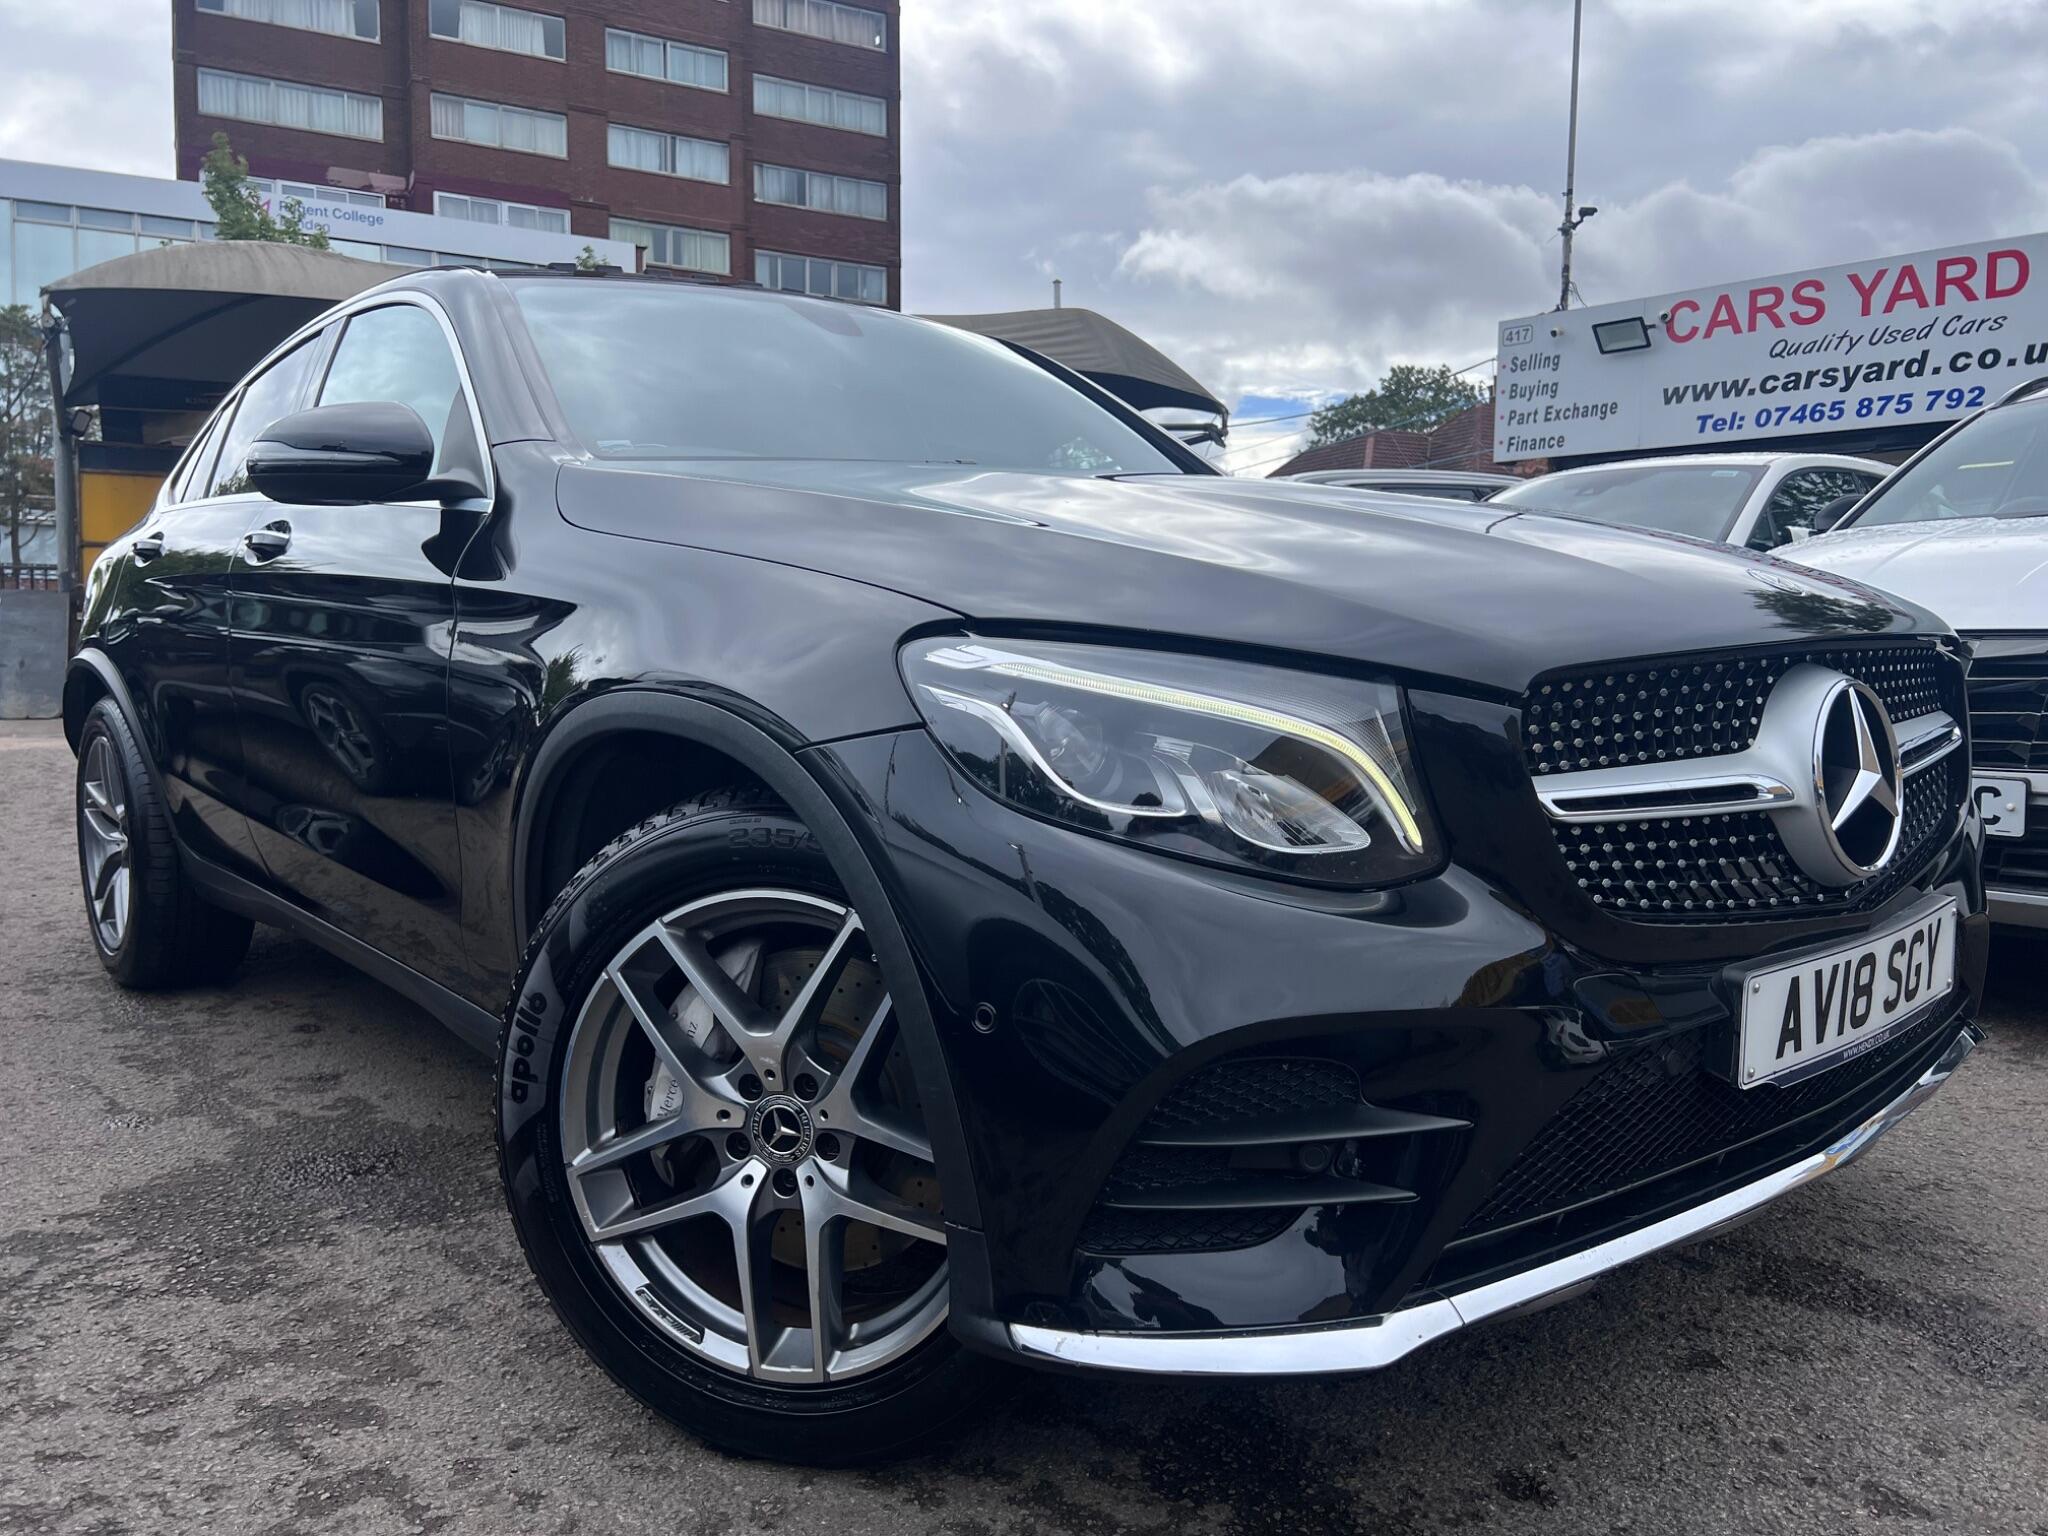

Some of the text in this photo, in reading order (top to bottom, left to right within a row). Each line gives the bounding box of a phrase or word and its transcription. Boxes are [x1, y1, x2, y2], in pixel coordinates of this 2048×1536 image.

[332, 207, 384, 227] College
[1665, 248, 2031, 344] CARS YARD
[1505, 328, 1530, 342] 417
[1768, 314, 2008, 359] Quality Used Cars
[1509, 352, 1561, 373] Selling
[1508, 379, 1559, 402] Buying
[1507, 401, 1618, 427] Part Exchange
[1696, 385, 1986, 434] Tel: 07465 875 792
[1506, 434, 1565, 453] Finance
[1775, 917, 1942, 1060] AV18 SGY
[511, 991, 547, 1105] apollo
